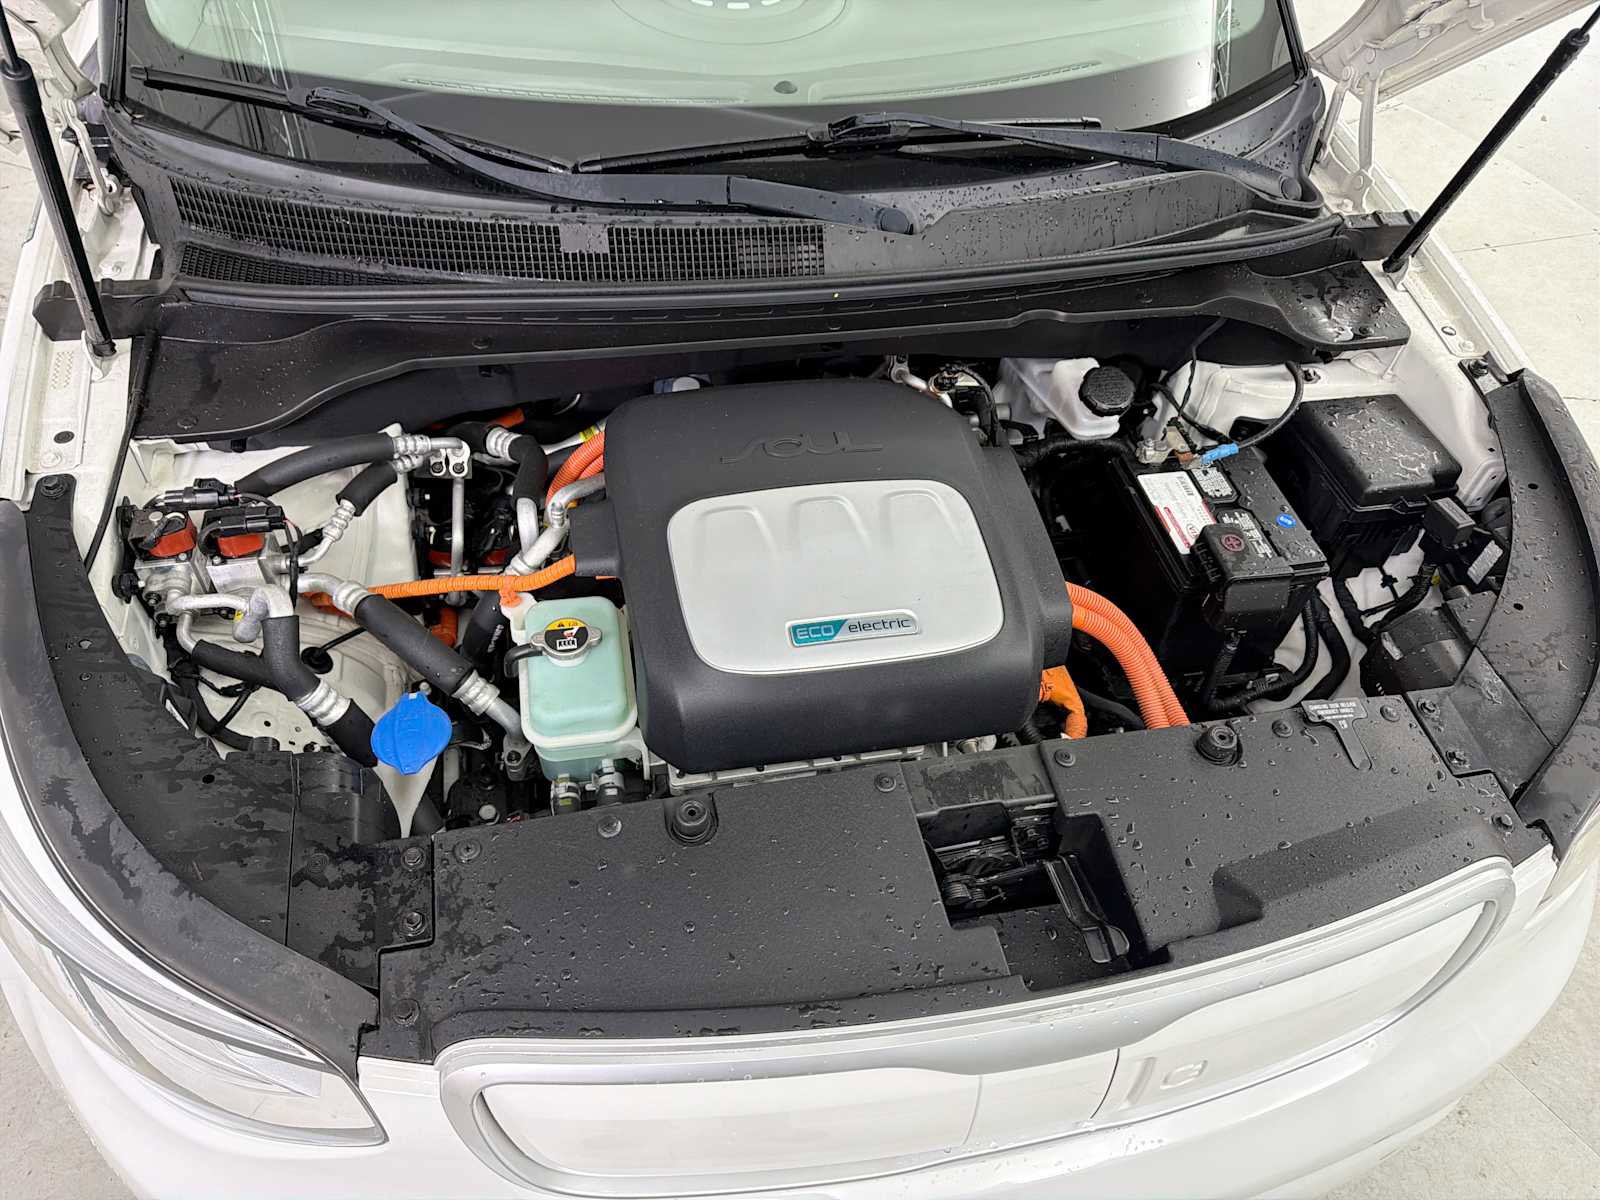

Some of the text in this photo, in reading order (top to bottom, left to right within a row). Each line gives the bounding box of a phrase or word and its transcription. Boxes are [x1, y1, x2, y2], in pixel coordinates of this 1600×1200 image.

[720, 431, 883, 464] SOUL
[796, 619, 912, 640] ECO electric
